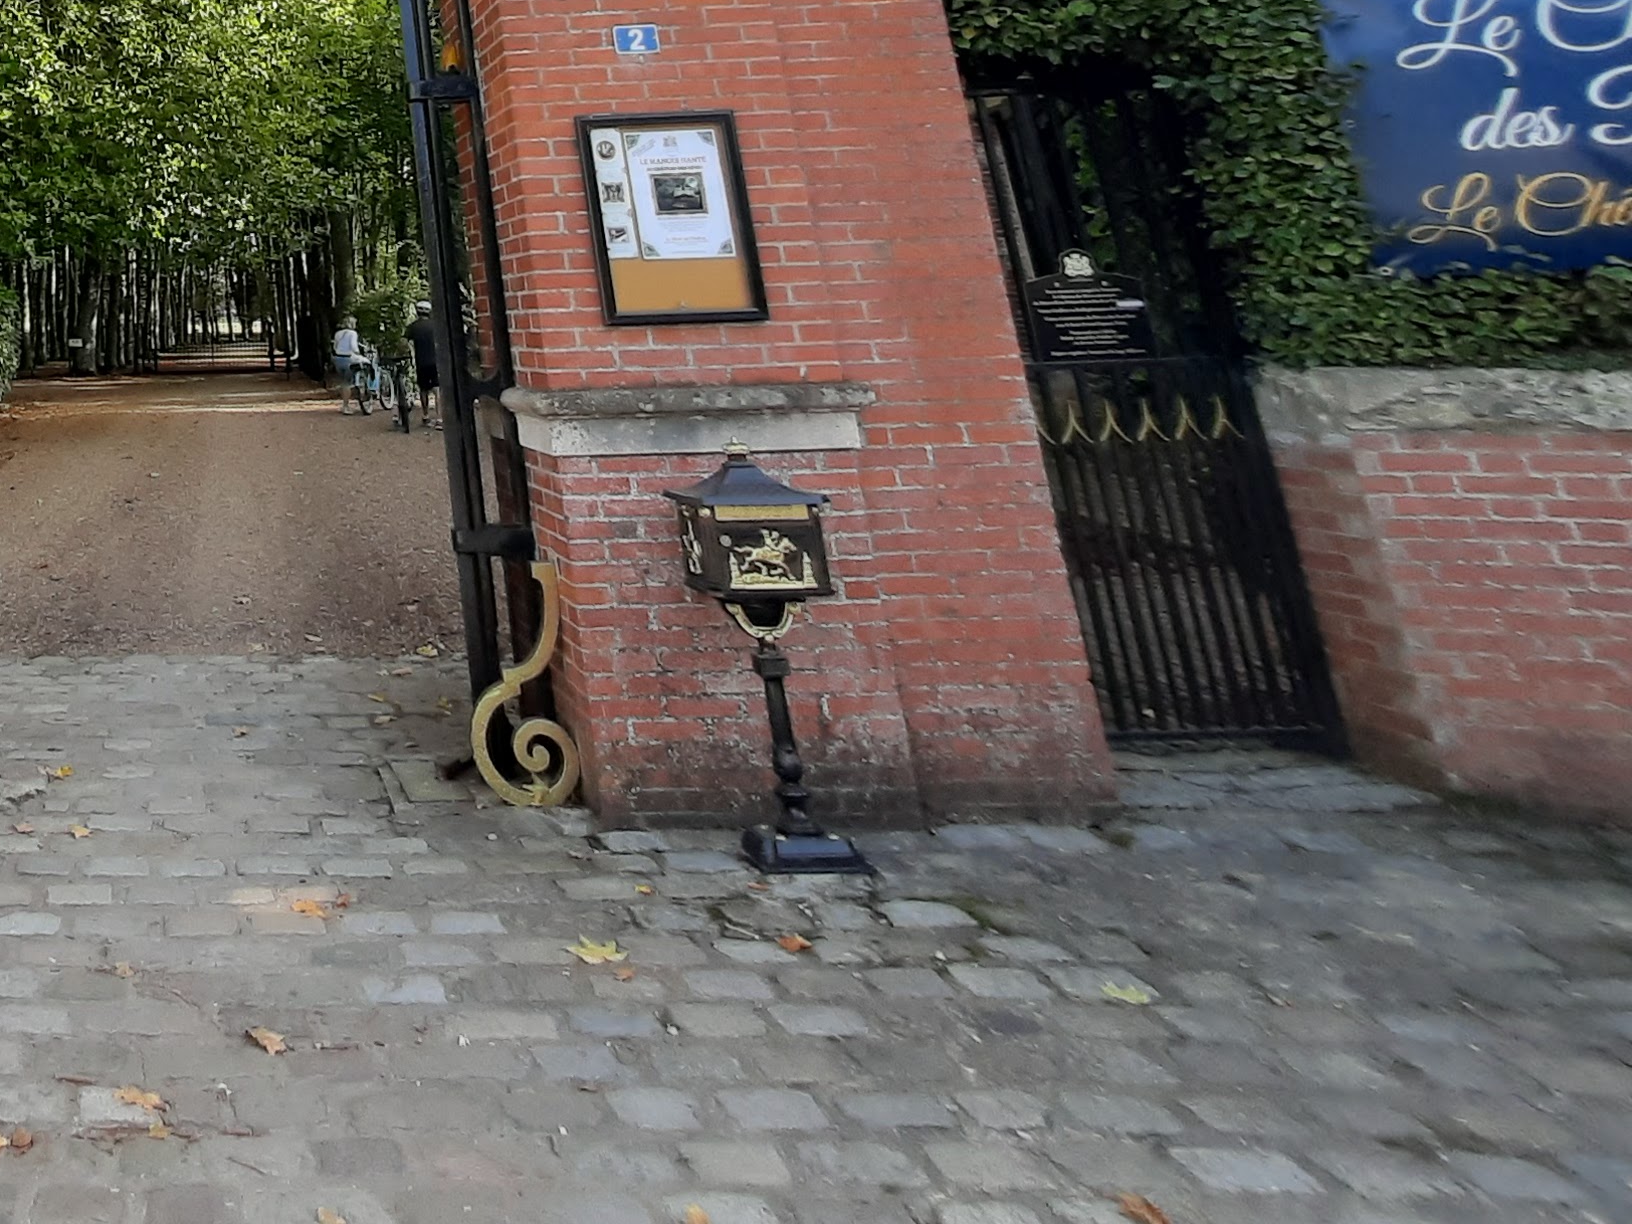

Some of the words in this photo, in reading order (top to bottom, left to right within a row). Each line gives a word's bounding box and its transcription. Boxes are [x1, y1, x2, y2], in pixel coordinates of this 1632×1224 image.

[628, 28, 645, 50] 2
[1460, 87, 1575, 151] des
[1408, 172, 1501, 252] Le
